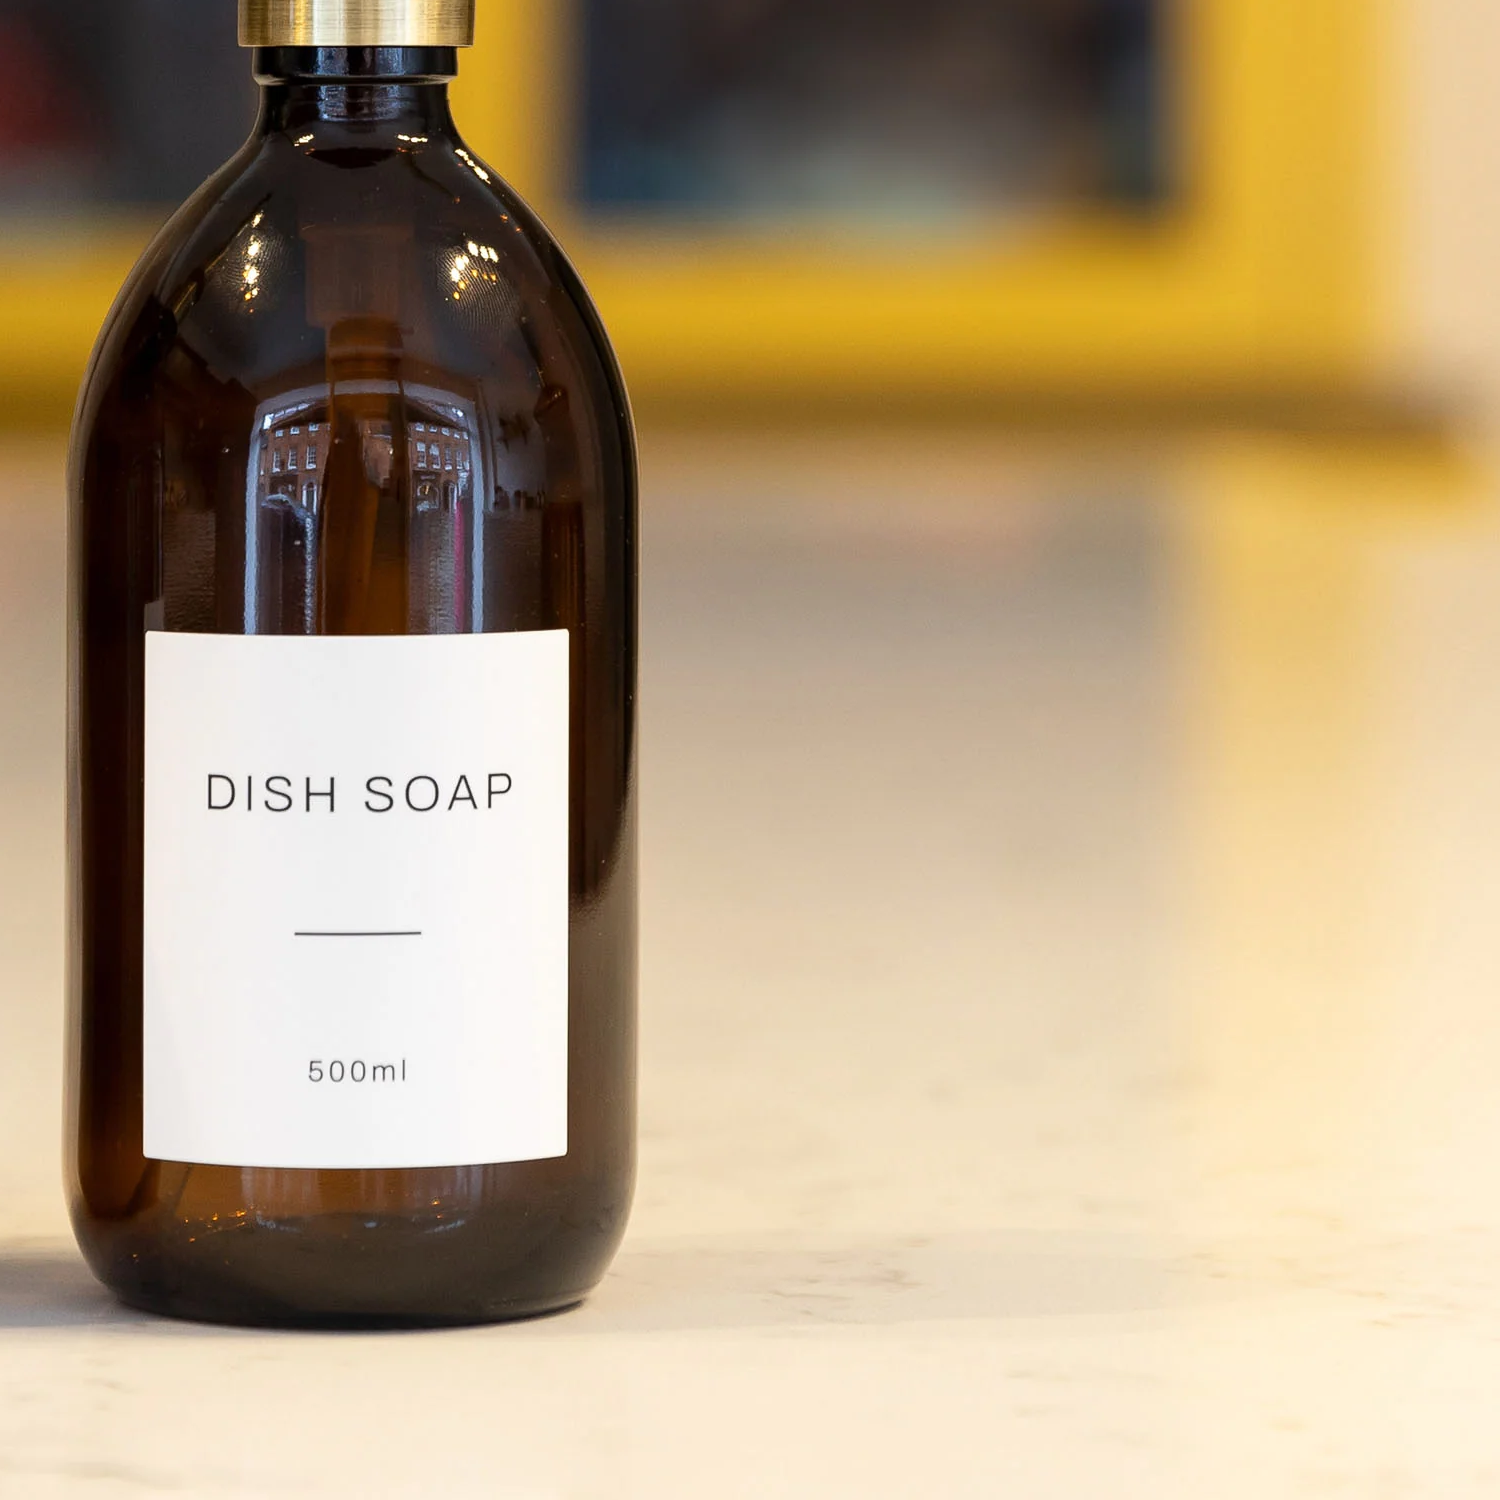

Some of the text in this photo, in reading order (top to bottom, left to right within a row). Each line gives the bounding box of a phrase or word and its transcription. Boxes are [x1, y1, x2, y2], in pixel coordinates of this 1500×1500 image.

[206, 772, 513, 814] DISH SOAP
[308, 1059, 406, 1083] 500ml
